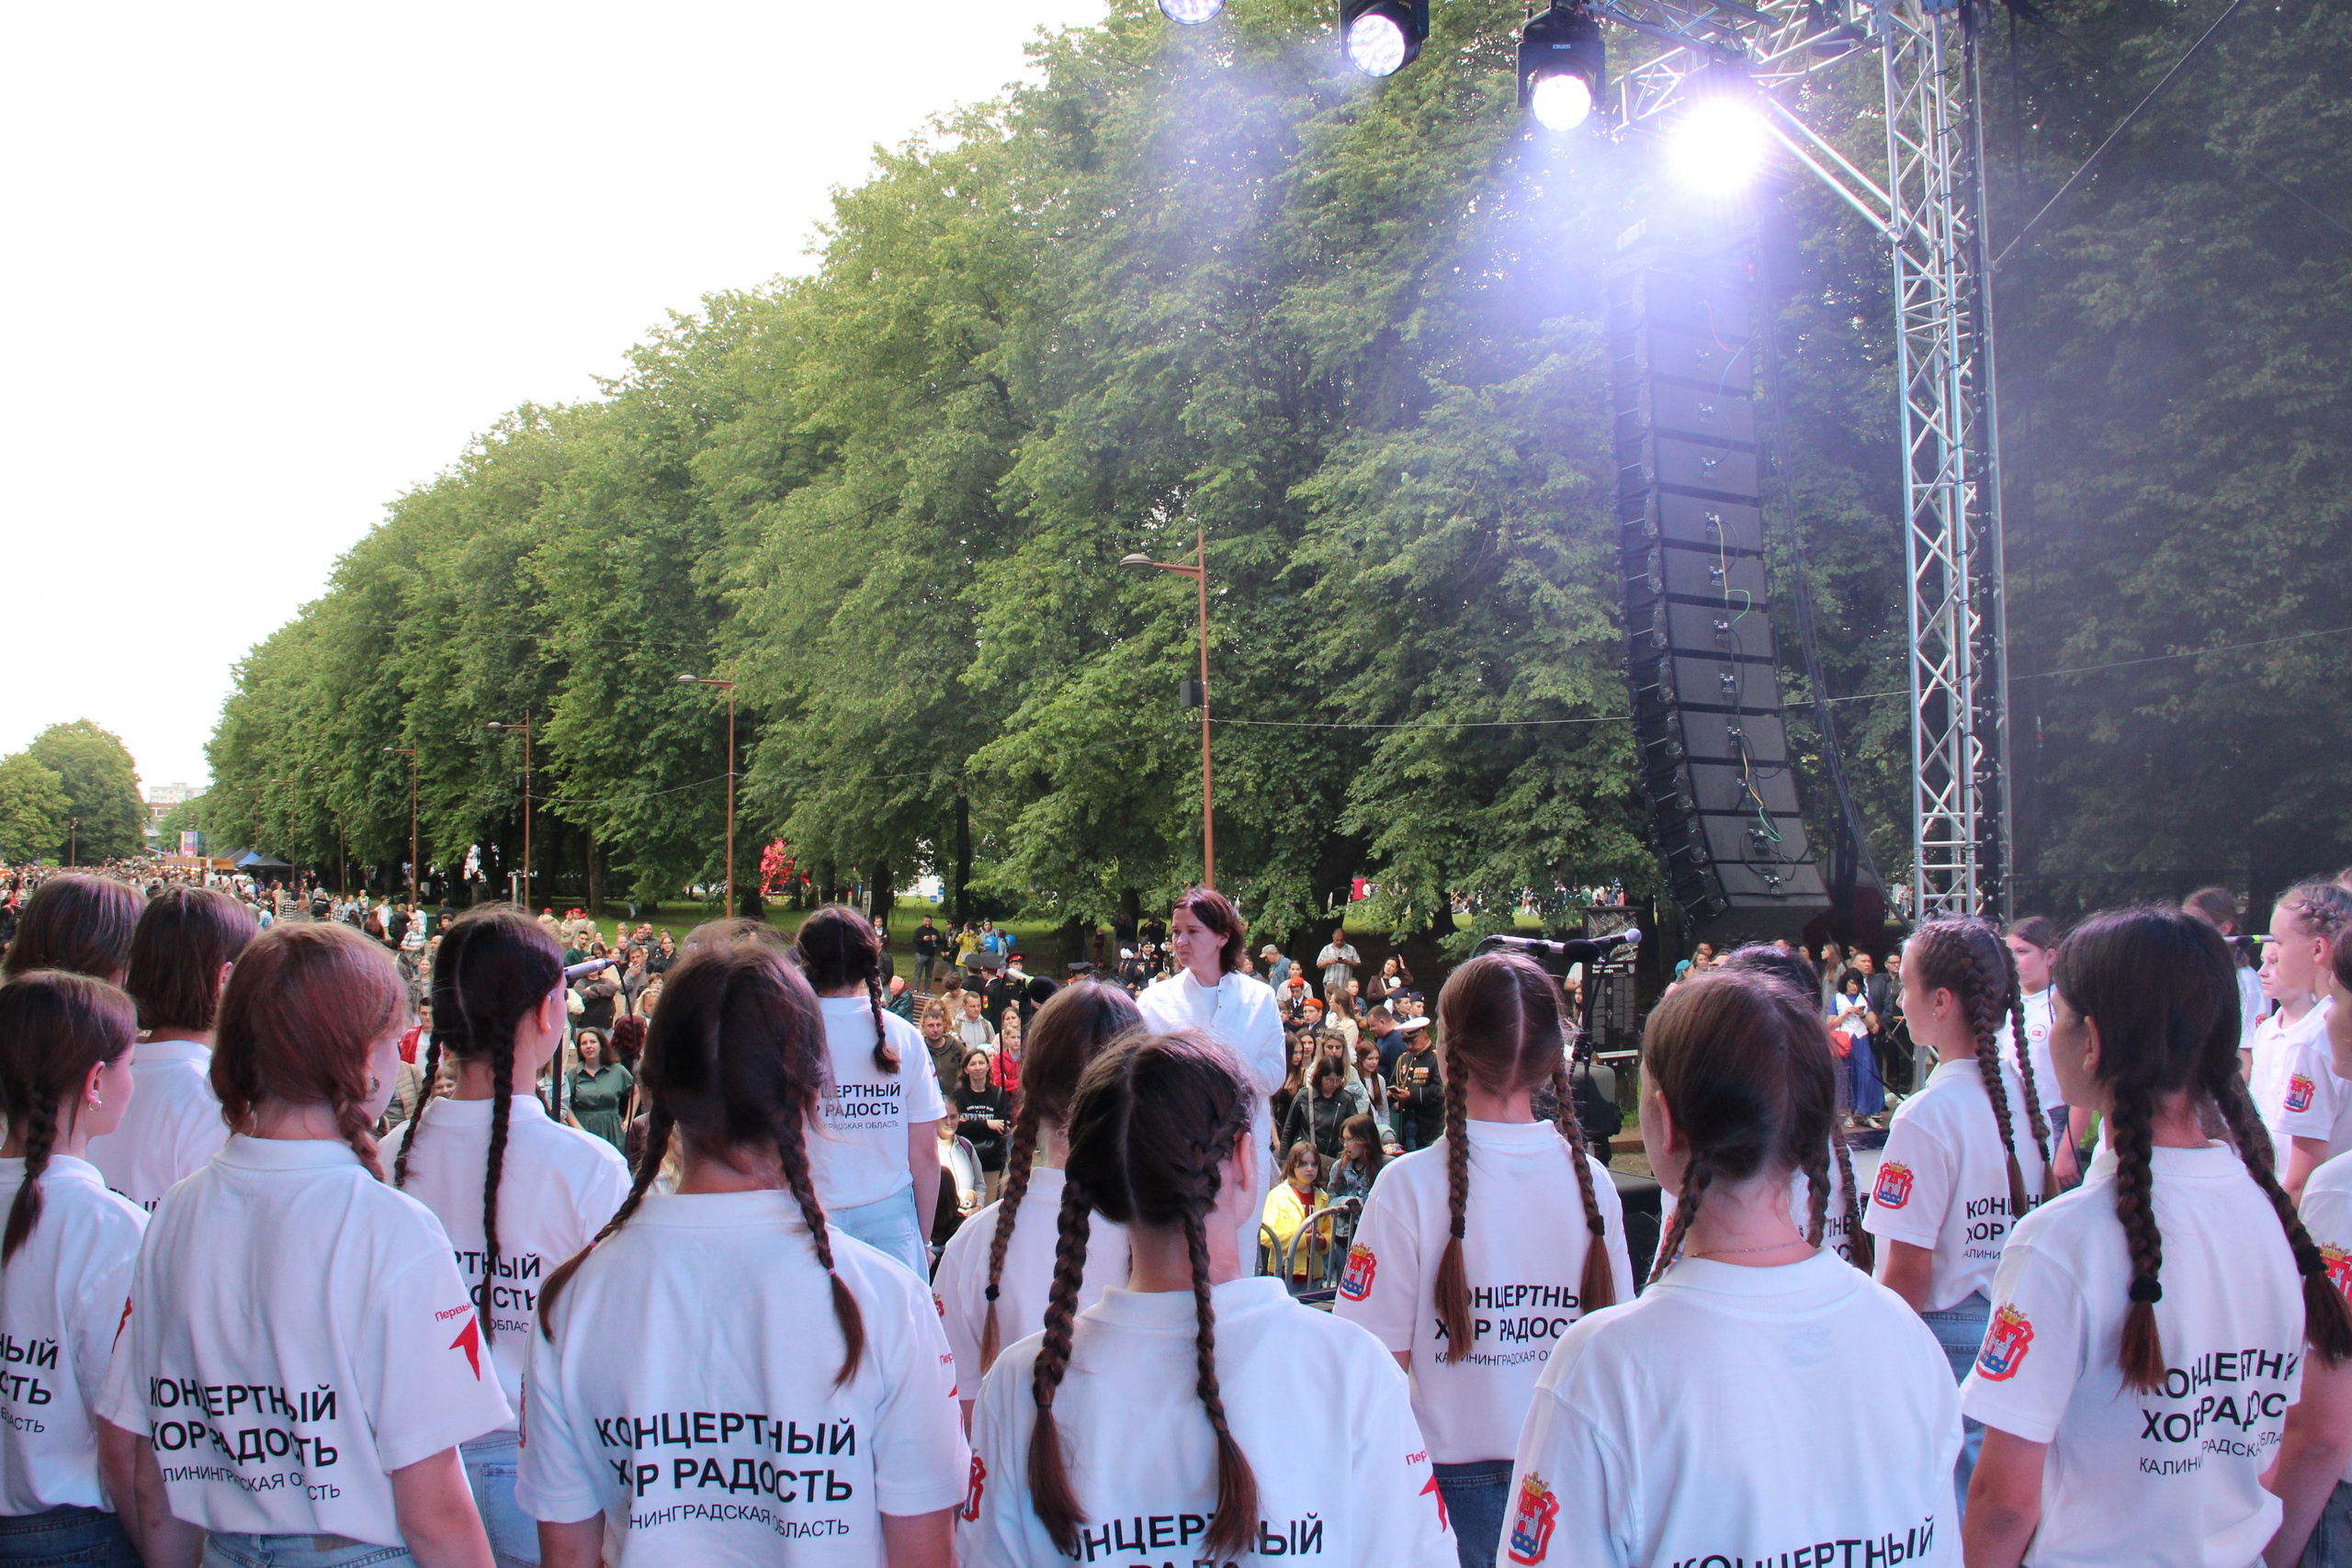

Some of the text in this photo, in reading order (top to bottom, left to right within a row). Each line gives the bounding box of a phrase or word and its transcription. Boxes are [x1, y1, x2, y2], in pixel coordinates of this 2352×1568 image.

[865, 1121, 899, 1130] ОБЛАСТЬ
[1965, 1223, 2005, 1245] ХОР
[1435, 1316, 1578, 1344] ХР РАДОС
[150, 1419, 207, 1451] ХОР
[594, 1412, 856, 1456] КОНЦЕРТНЫЙ
[609, 1458, 854, 1503] ХР РАДОСТЬ
[628, 1501, 850, 1539] НИНГРАДСКАЯ ОБЛАСТЬ
